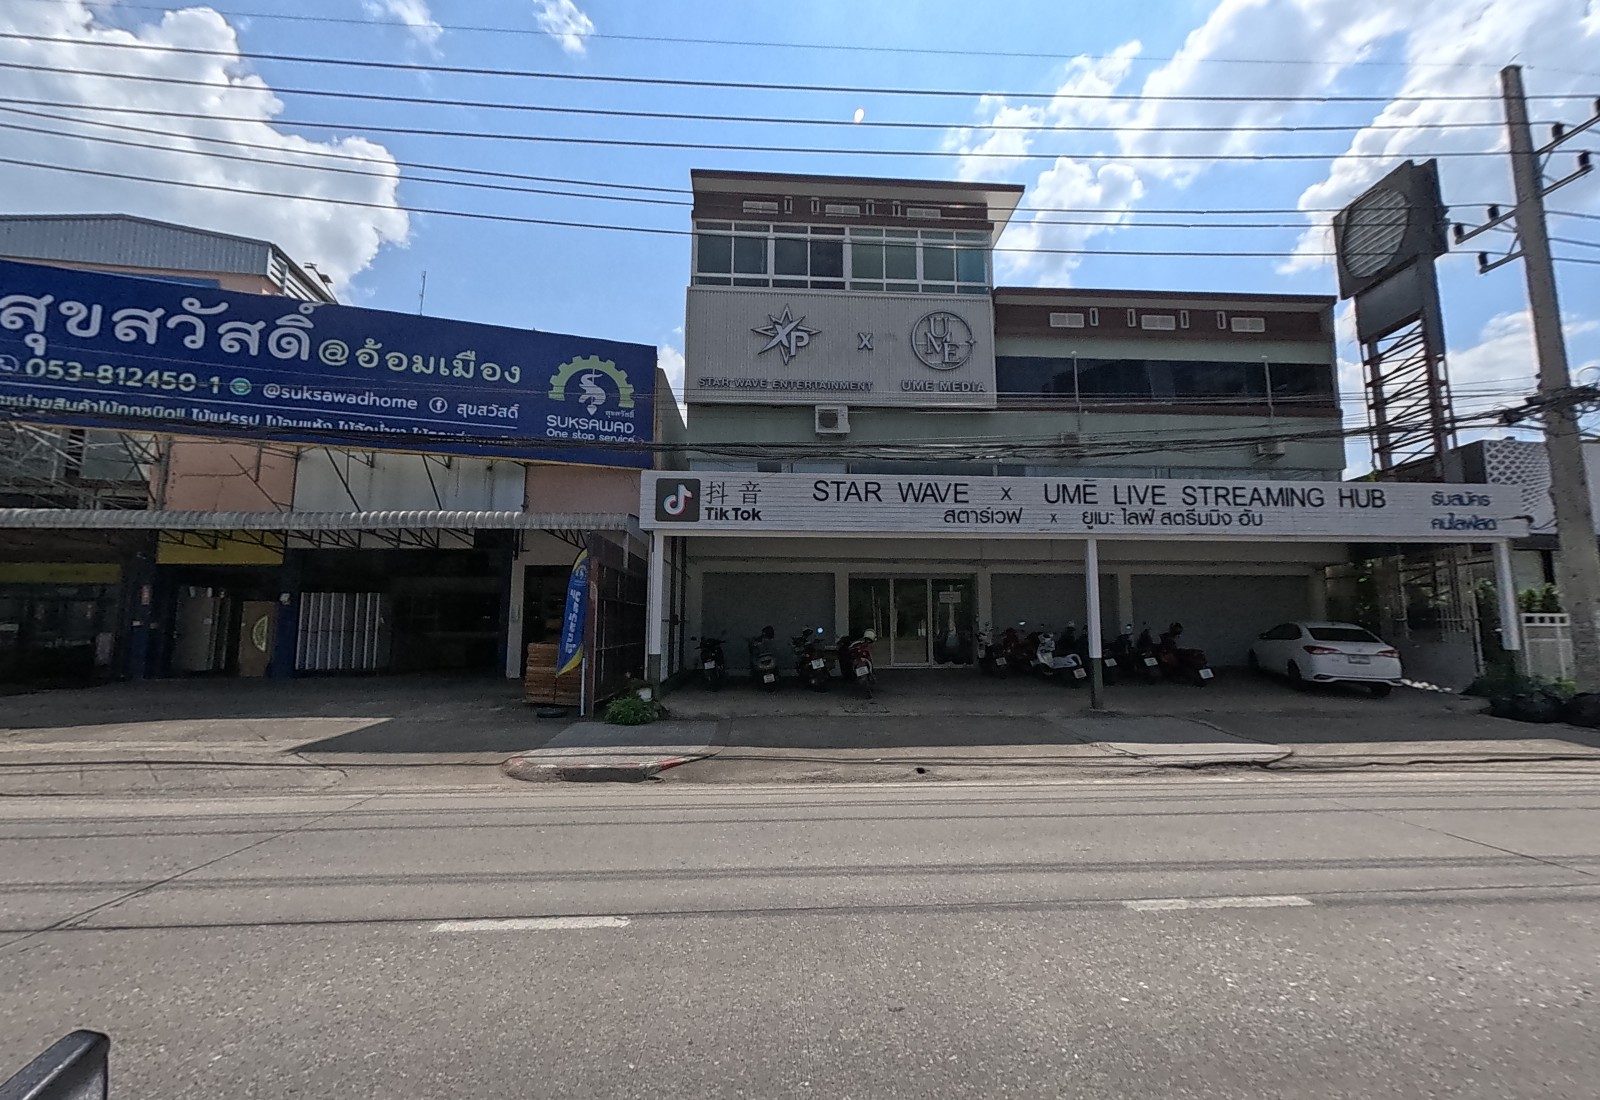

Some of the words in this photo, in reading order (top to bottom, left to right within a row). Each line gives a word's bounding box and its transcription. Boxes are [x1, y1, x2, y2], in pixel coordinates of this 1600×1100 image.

[0, 294, 322, 362] สุขสวัสดิ์
[319, 338, 521, 384] @อ้อมเมือง
[698, 377, 730, 388] STAR
[735, 378, 768, 389] WAVE
[772, 379, 874, 392] ENTERTAINMENT
[901, 380, 934, 391] UME
[939, 381, 986, 392] MEDIA
[263, 383, 418, 410] @suksawadhome
[546, 414, 635, 434] SUKSAWAD
[546, 428, 568, 438] One
[705, 480, 762, 505] 抖音
[812, 480, 882, 502] STAR
[898, 482, 970, 503] WAVE
[1113, 484, 1166, 506] LIVE
[1181, 485, 1324, 508] STREAMING
[1339, 488, 1386, 508] HUB
[705, 506, 762, 521] TikTok
[943, 506, 1023, 524] สตาร์เวฟ
